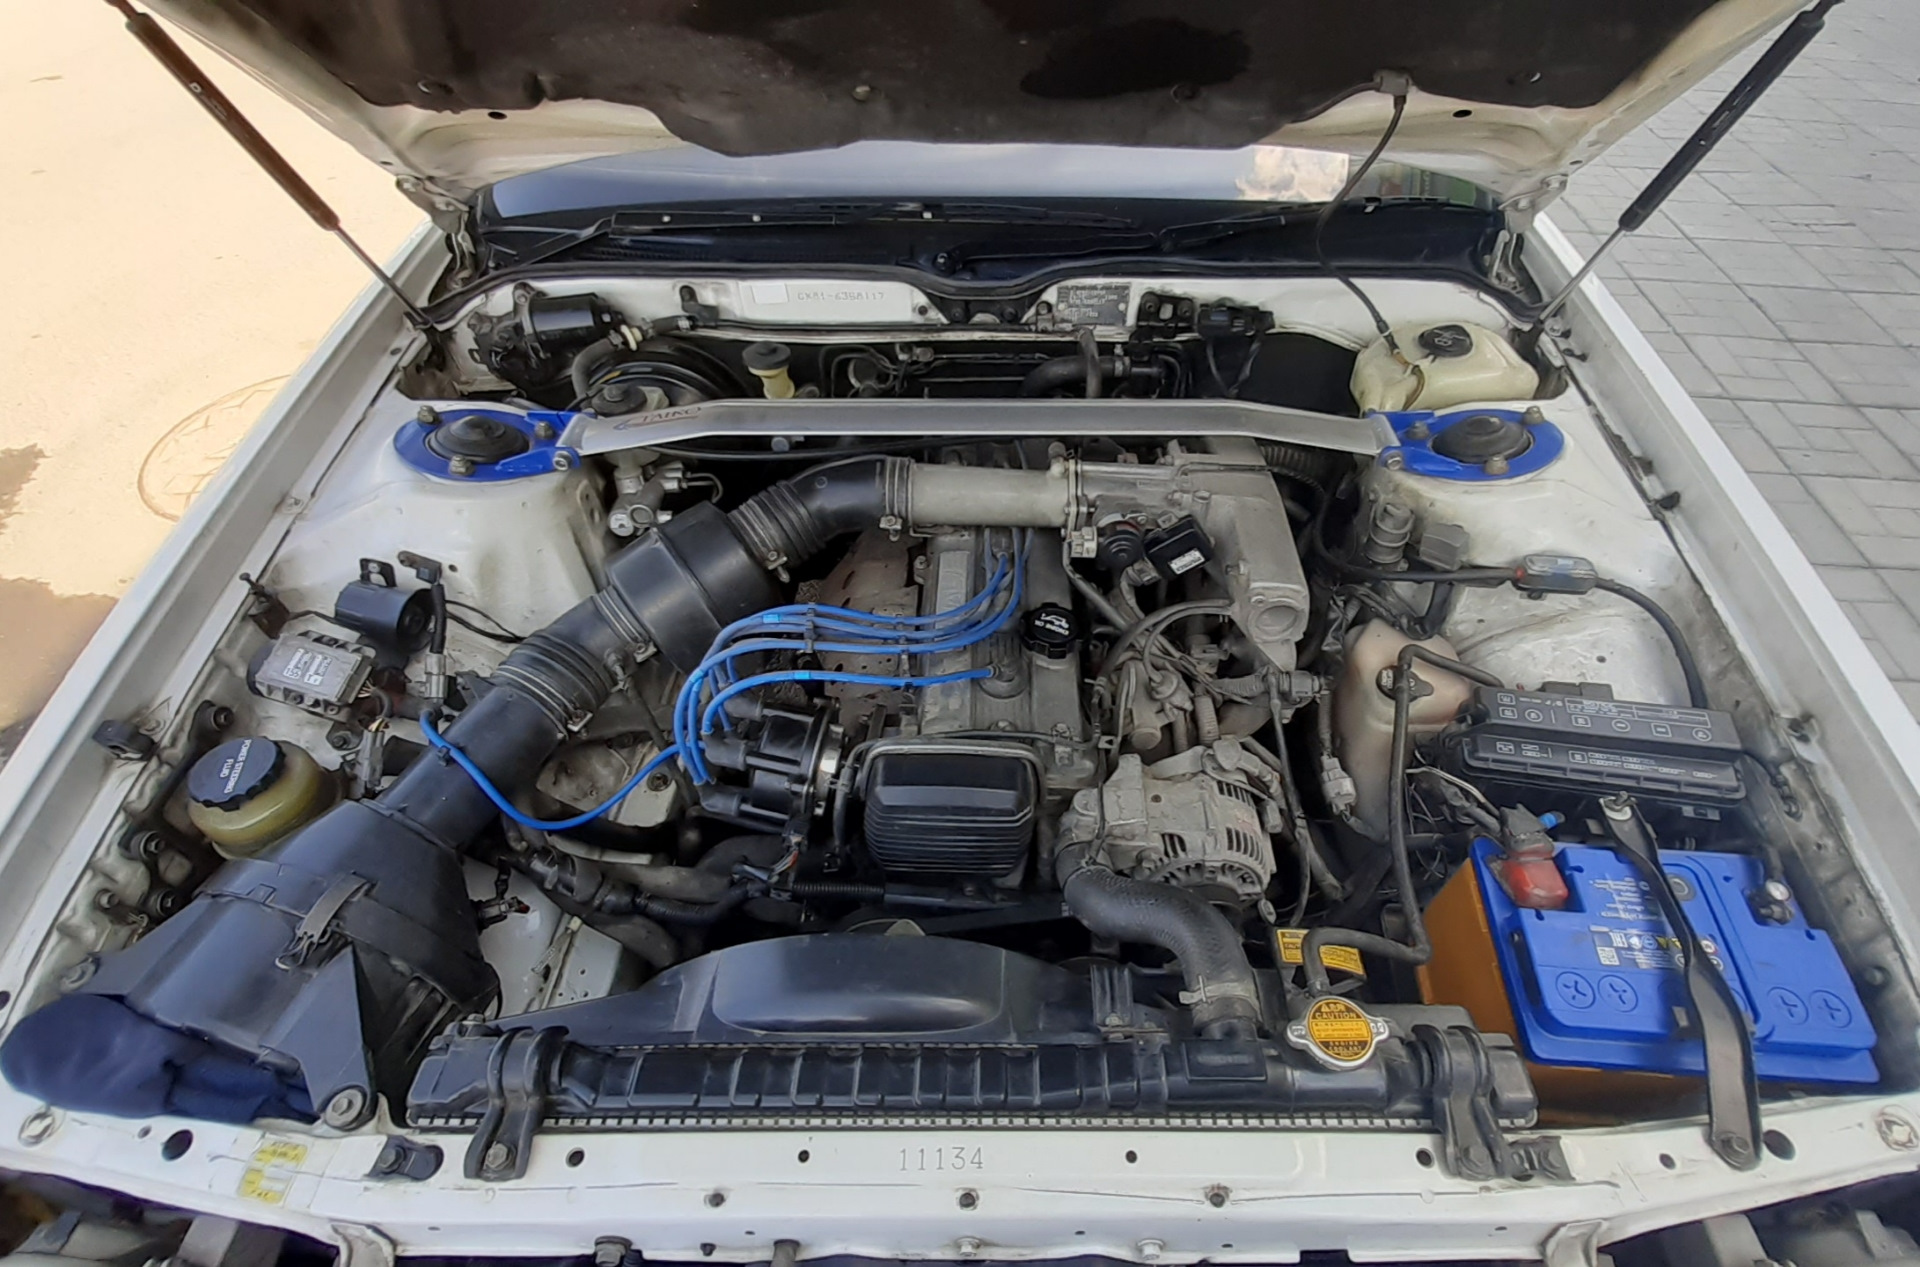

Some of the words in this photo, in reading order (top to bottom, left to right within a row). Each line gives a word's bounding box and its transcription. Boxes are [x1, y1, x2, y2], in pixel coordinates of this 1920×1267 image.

[236, 739, 252, 762] POWER
[219, 758, 235, 778] FLUID
[1315, 1012, 1357, 1020] CAUTION
[900, 1146, 984, 1171] 11134
